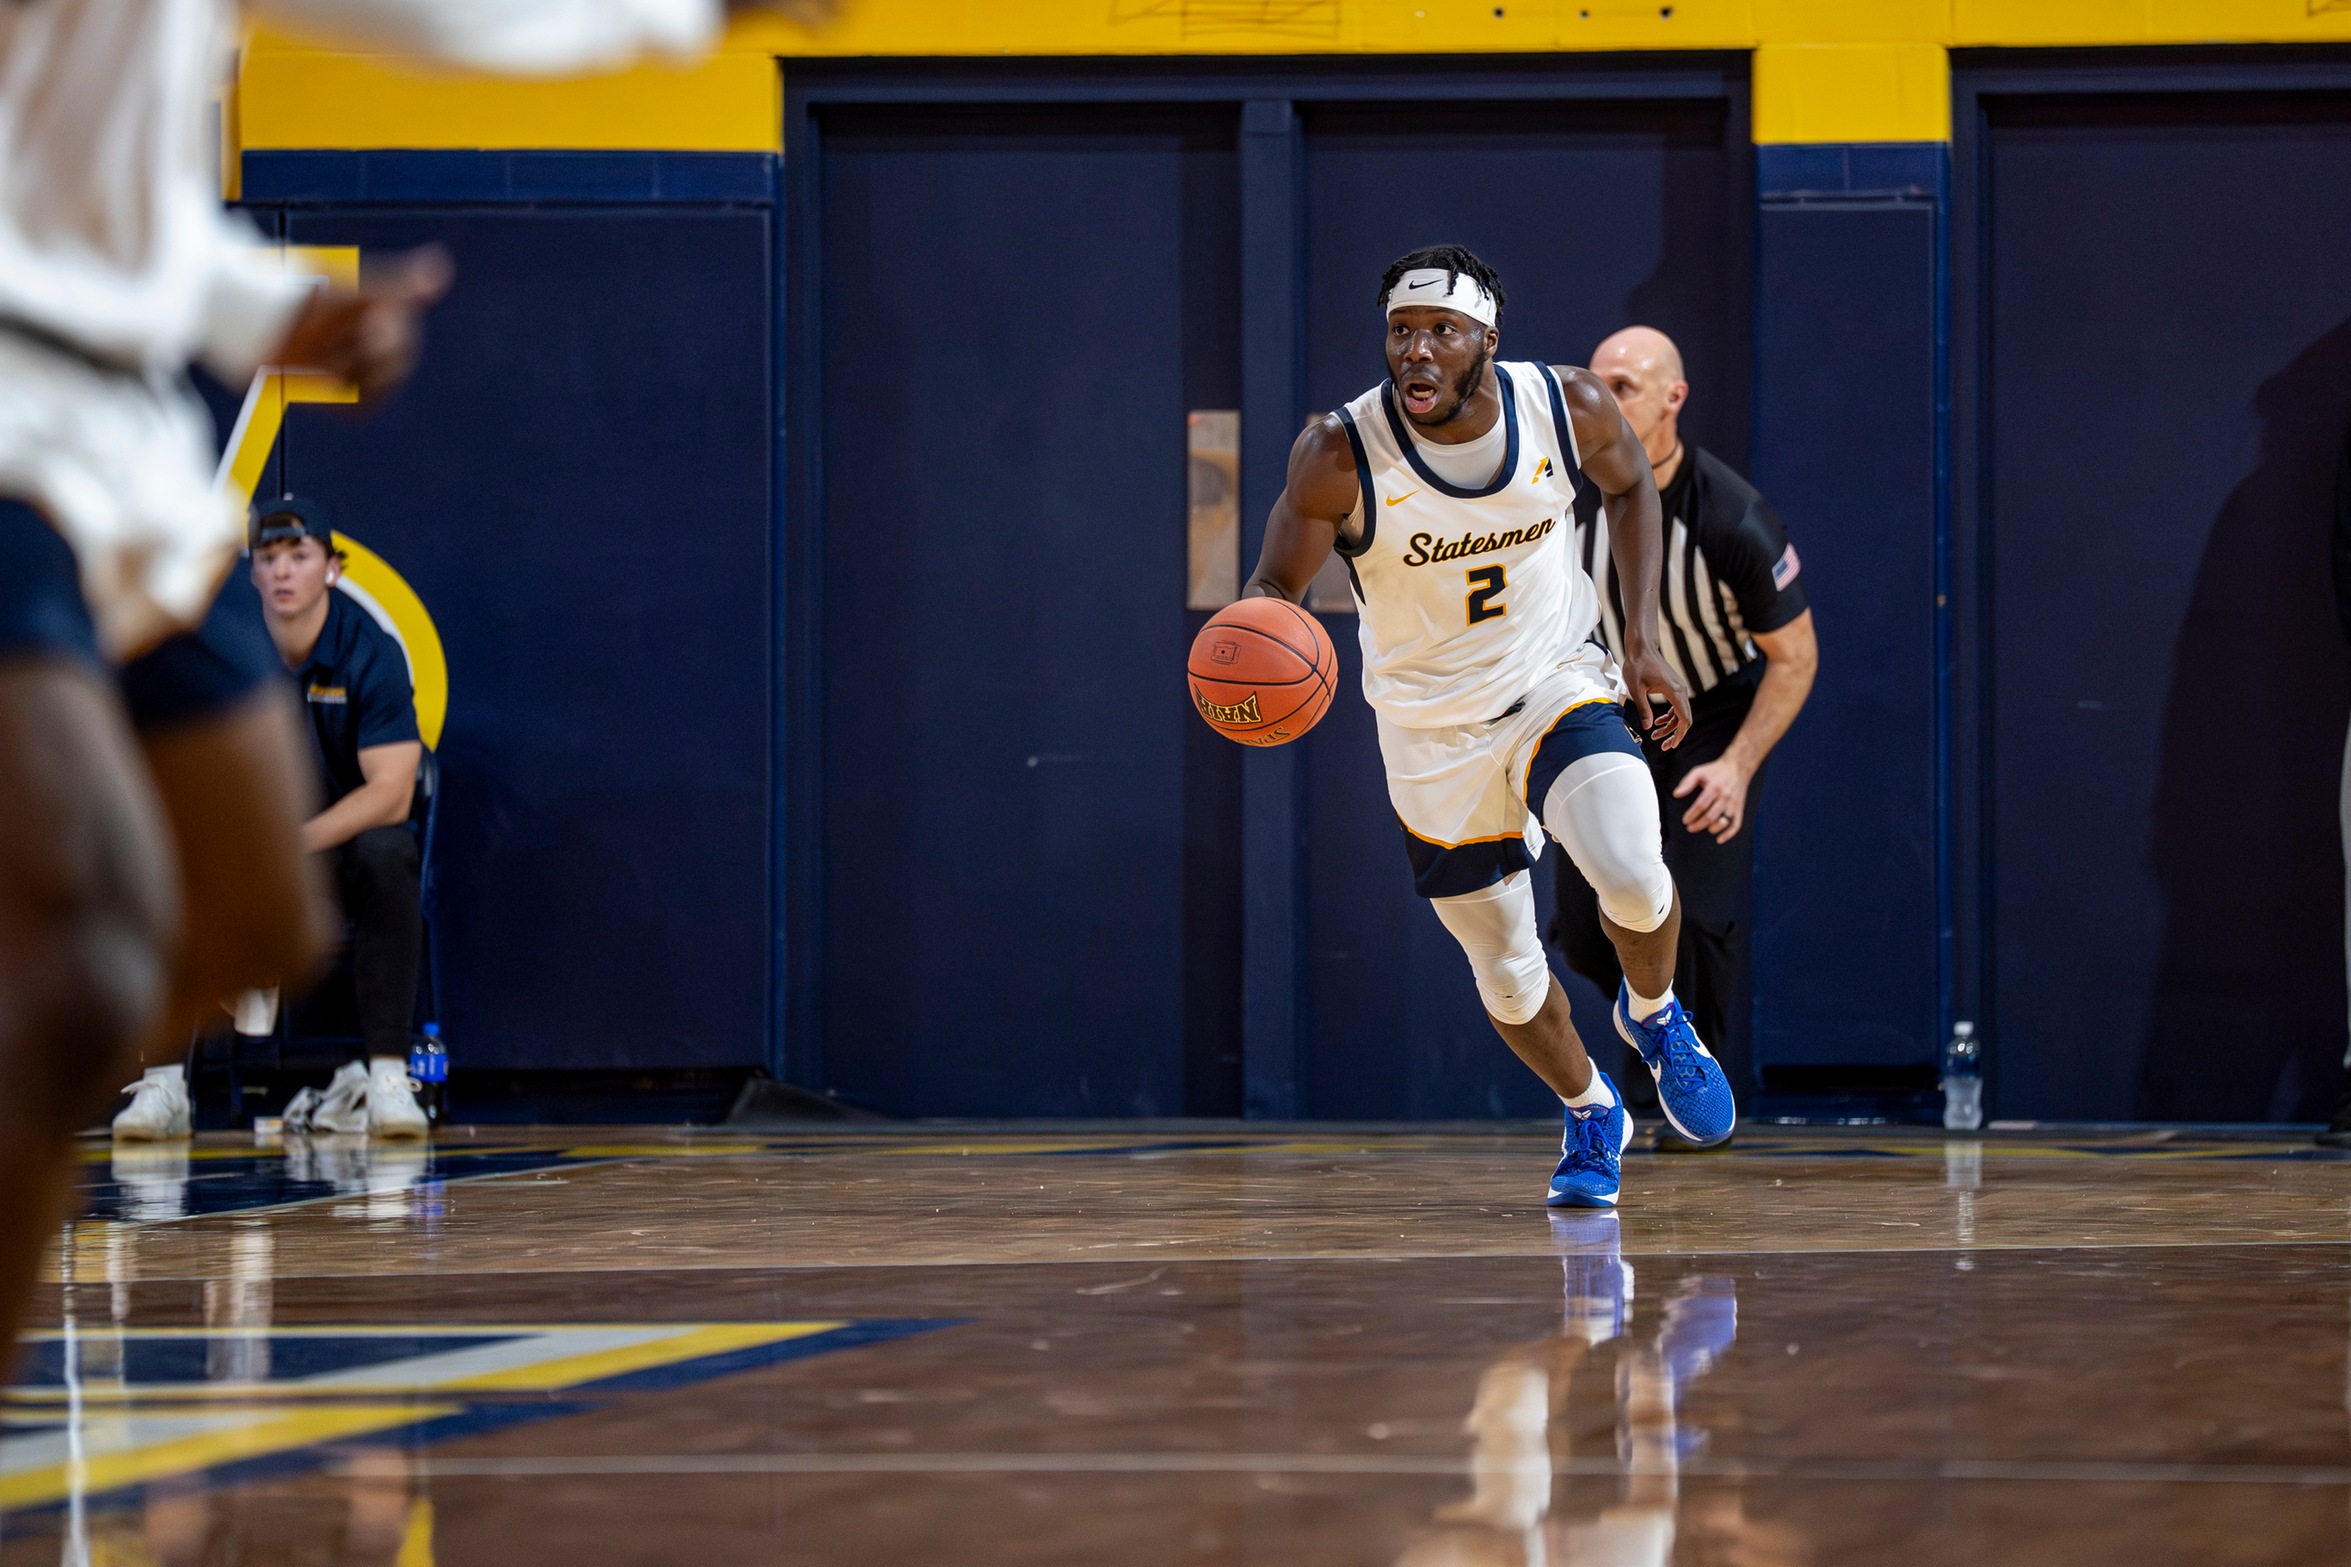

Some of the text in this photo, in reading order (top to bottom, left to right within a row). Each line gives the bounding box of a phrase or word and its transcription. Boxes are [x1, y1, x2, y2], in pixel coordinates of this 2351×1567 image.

[1403, 518, 1556, 567] Statesmen
[1465, 563, 1508, 627] 2
[1197, 691, 1262, 722] NAIA
